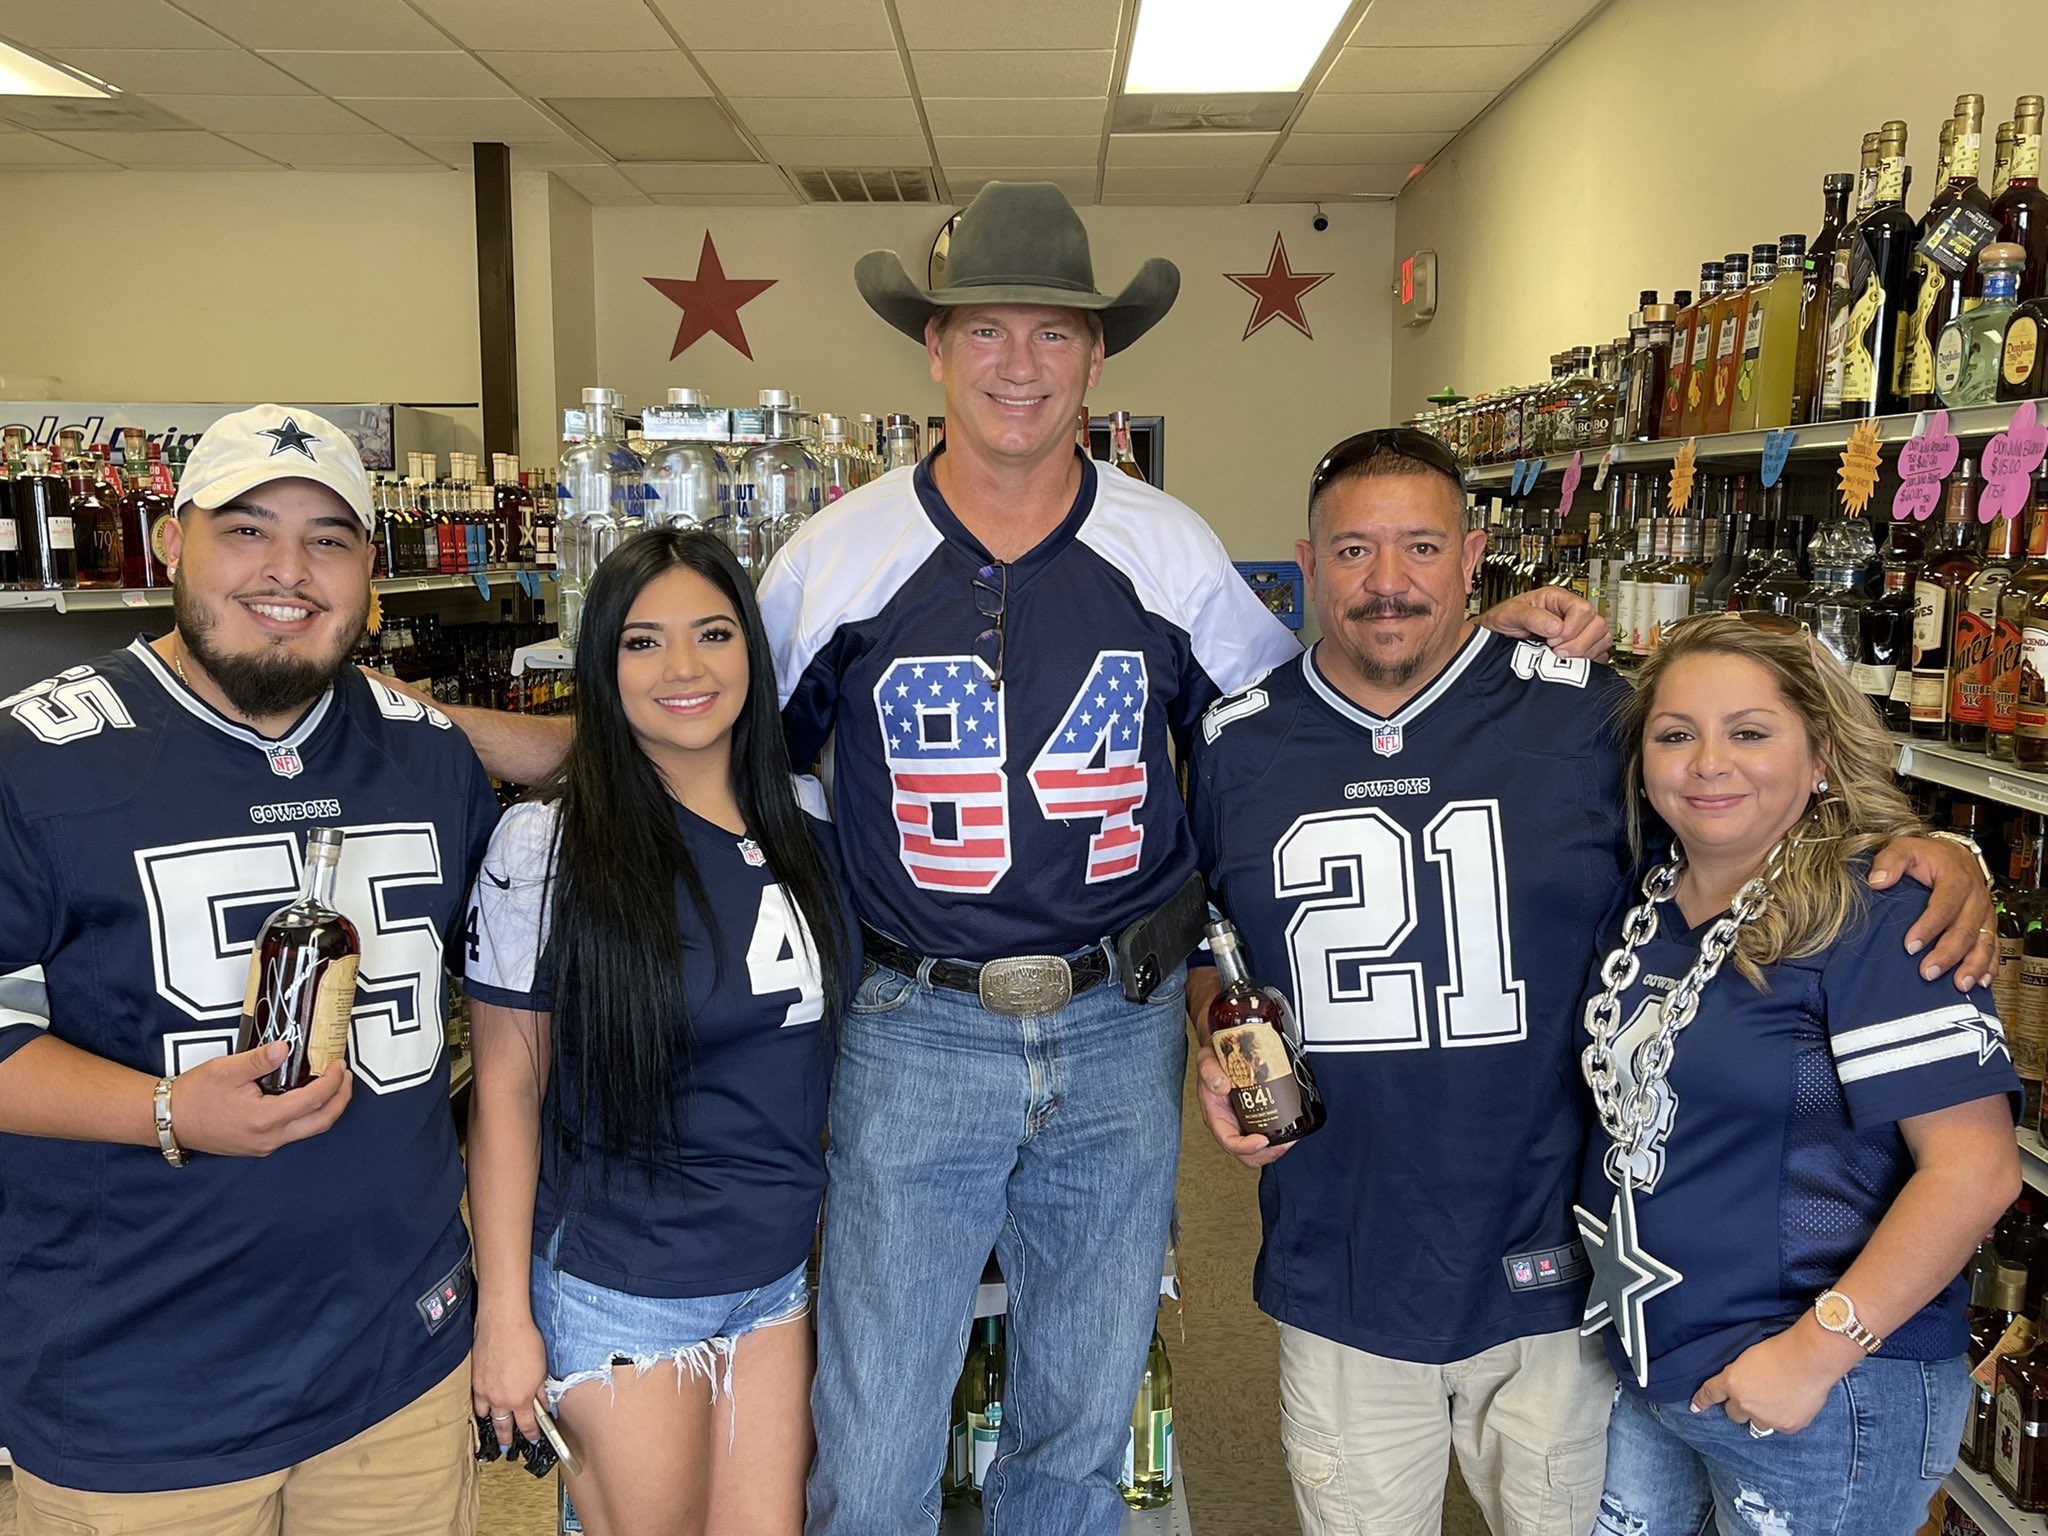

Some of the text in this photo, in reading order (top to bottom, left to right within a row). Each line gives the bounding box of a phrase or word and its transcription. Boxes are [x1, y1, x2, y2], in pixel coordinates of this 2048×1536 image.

[1724, 273, 1745, 283] 800
[1963, 695, 1981, 706] SEC
[1376, 737, 1399, 750] NFL
[274, 756, 299, 772] NFL
[872, 650, 1150, 895] 84
[1345, 777, 1430, 799] COWBOYS
[250, 799, 341, 824] COWBOYS
[1273, 799, 1528, 1050] 21
[133, 822, 444, 1095] 55
[745, 881, 825, 1028] 4
